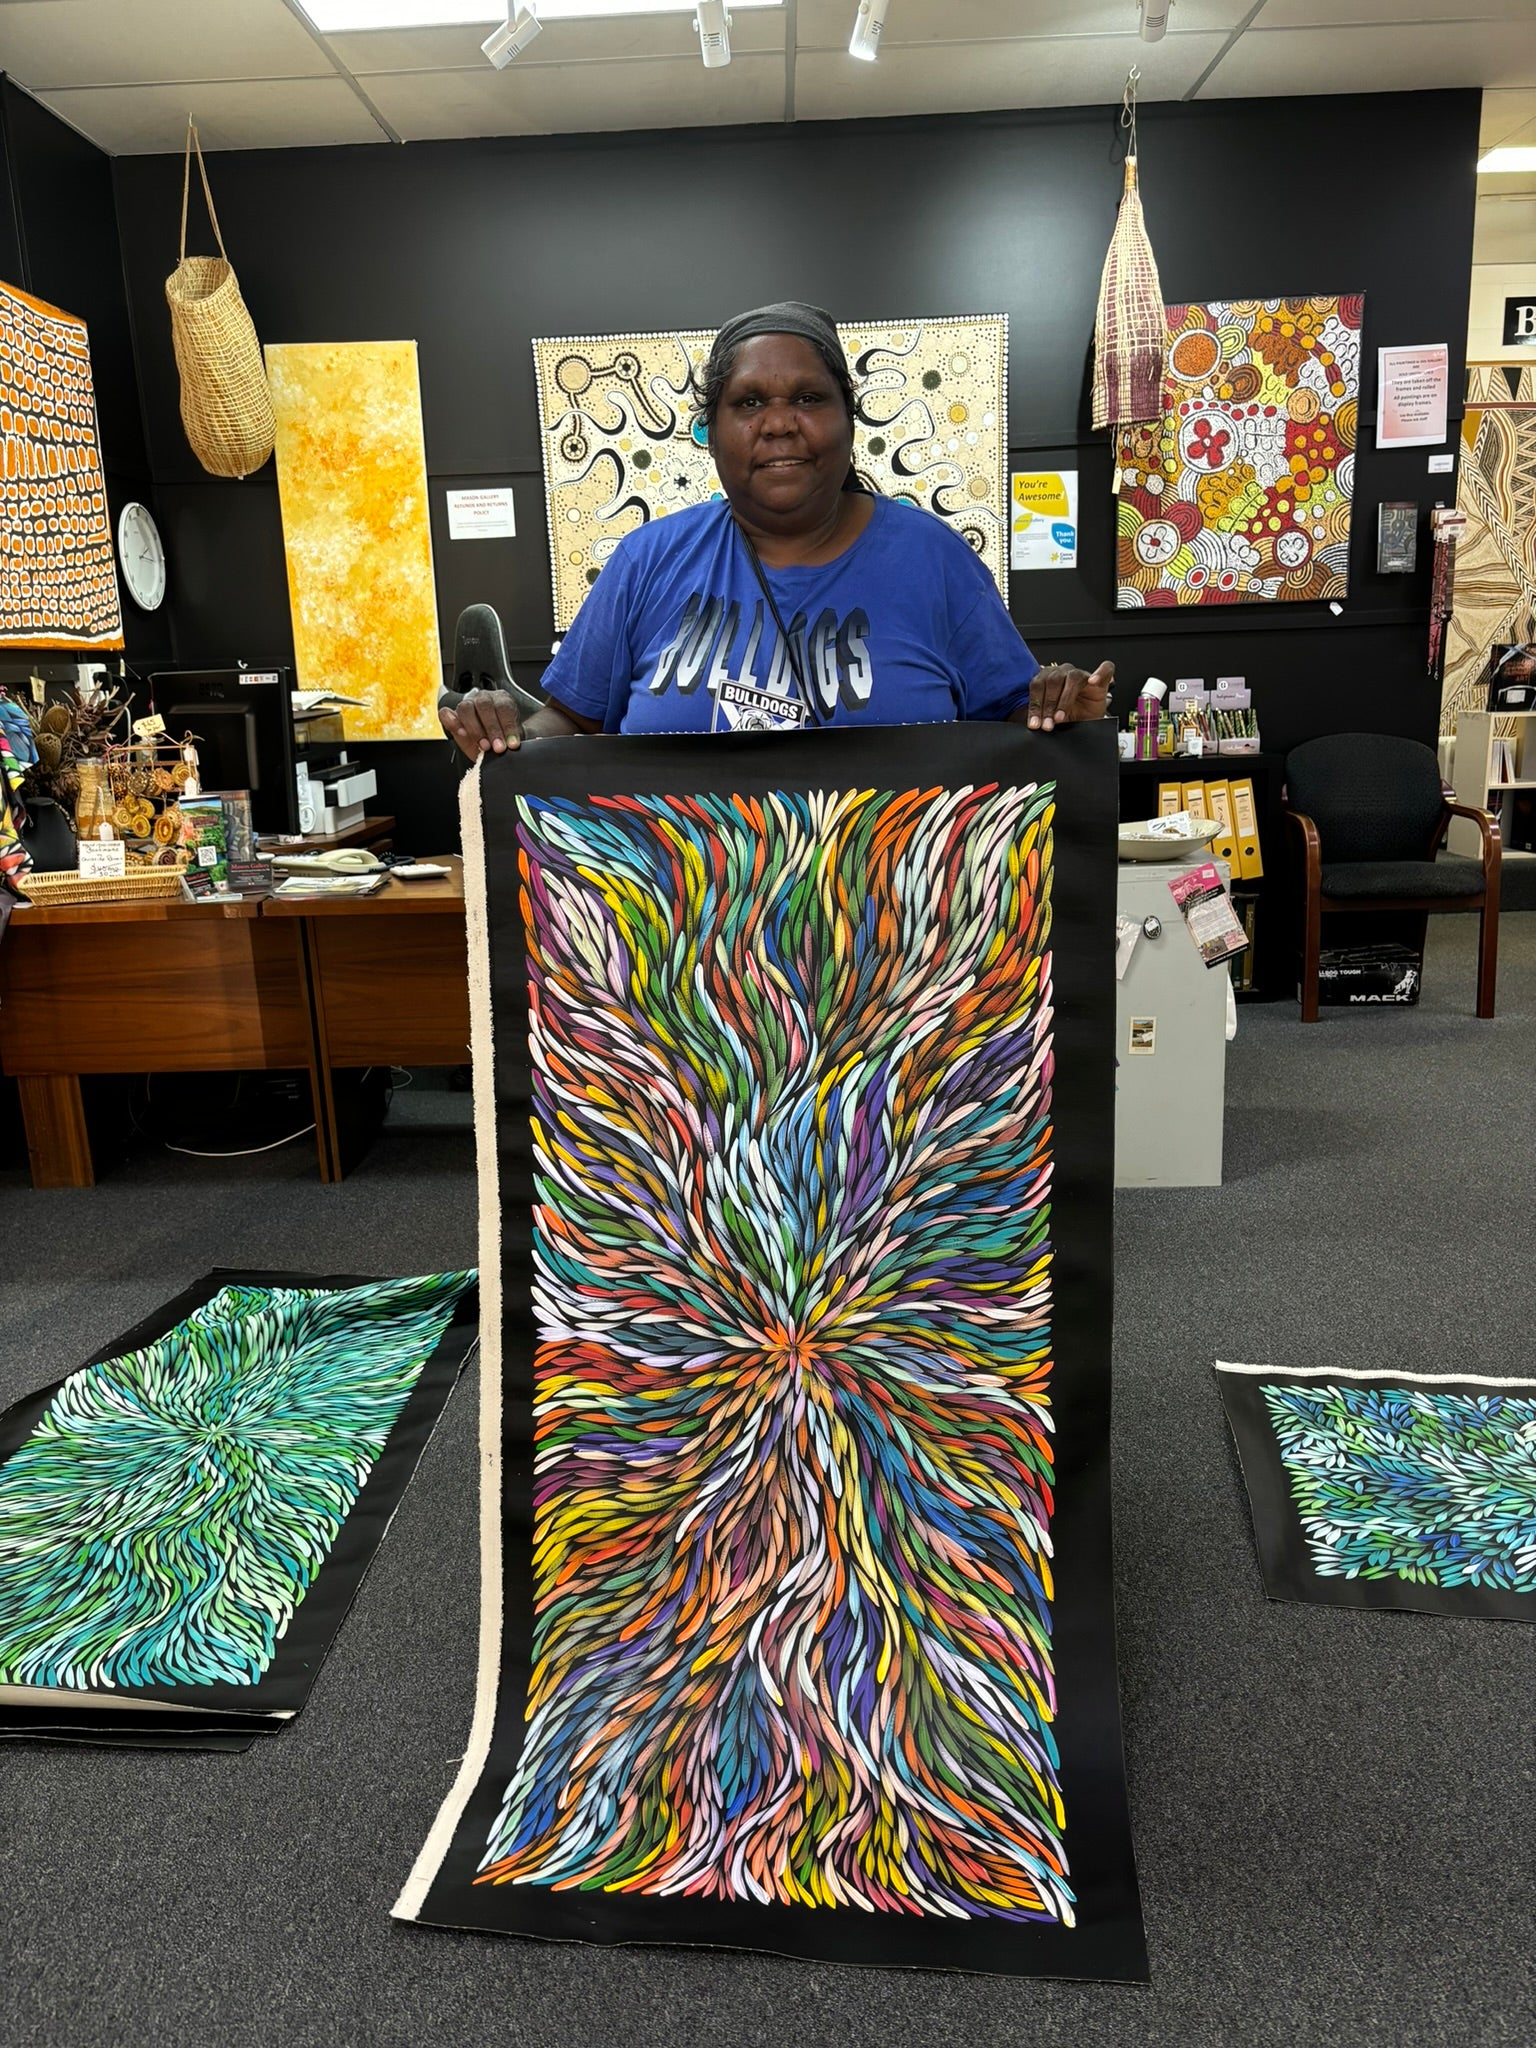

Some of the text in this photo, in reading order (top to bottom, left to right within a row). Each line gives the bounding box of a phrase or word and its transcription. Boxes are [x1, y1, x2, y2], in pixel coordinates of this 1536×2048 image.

[1019, 480, 1048, 489] You're
[724, 686, 799, 720] BULLDOGS
[1349, 994, 1409, 1002] MACK
